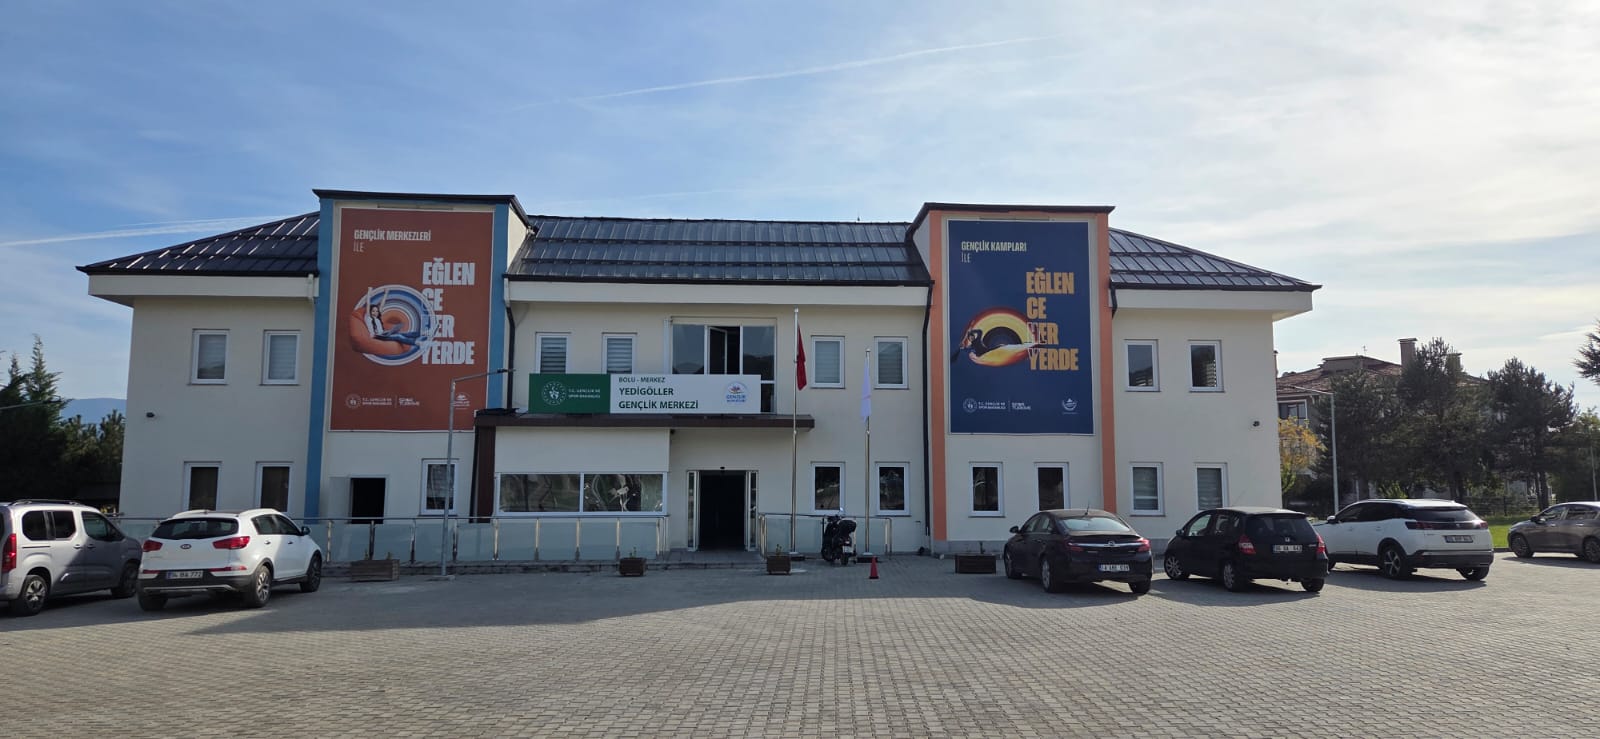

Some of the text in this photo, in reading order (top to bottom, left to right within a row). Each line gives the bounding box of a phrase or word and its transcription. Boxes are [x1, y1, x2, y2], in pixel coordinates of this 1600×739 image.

[354, 229, 431, 242] GENÇLİK MERKEZLERİ
[961, 240, 1027, 252] GENÇLİK KAMPLARI
[961, 252, 971, 263] İLE
[422, 257, 475, 285] EĞLEN
[1026, 267, 1075, 294] EĞLEN
[1026, 297, 1047, 319] CE
[421, 340, 475, 364] YERDE
[1028, 348, 1079, 370] YERDE
[619, 386, 674, 396] YEDİGÖLLER
[618, 400, 698, 411] GENÇLİK MERKEZİ
